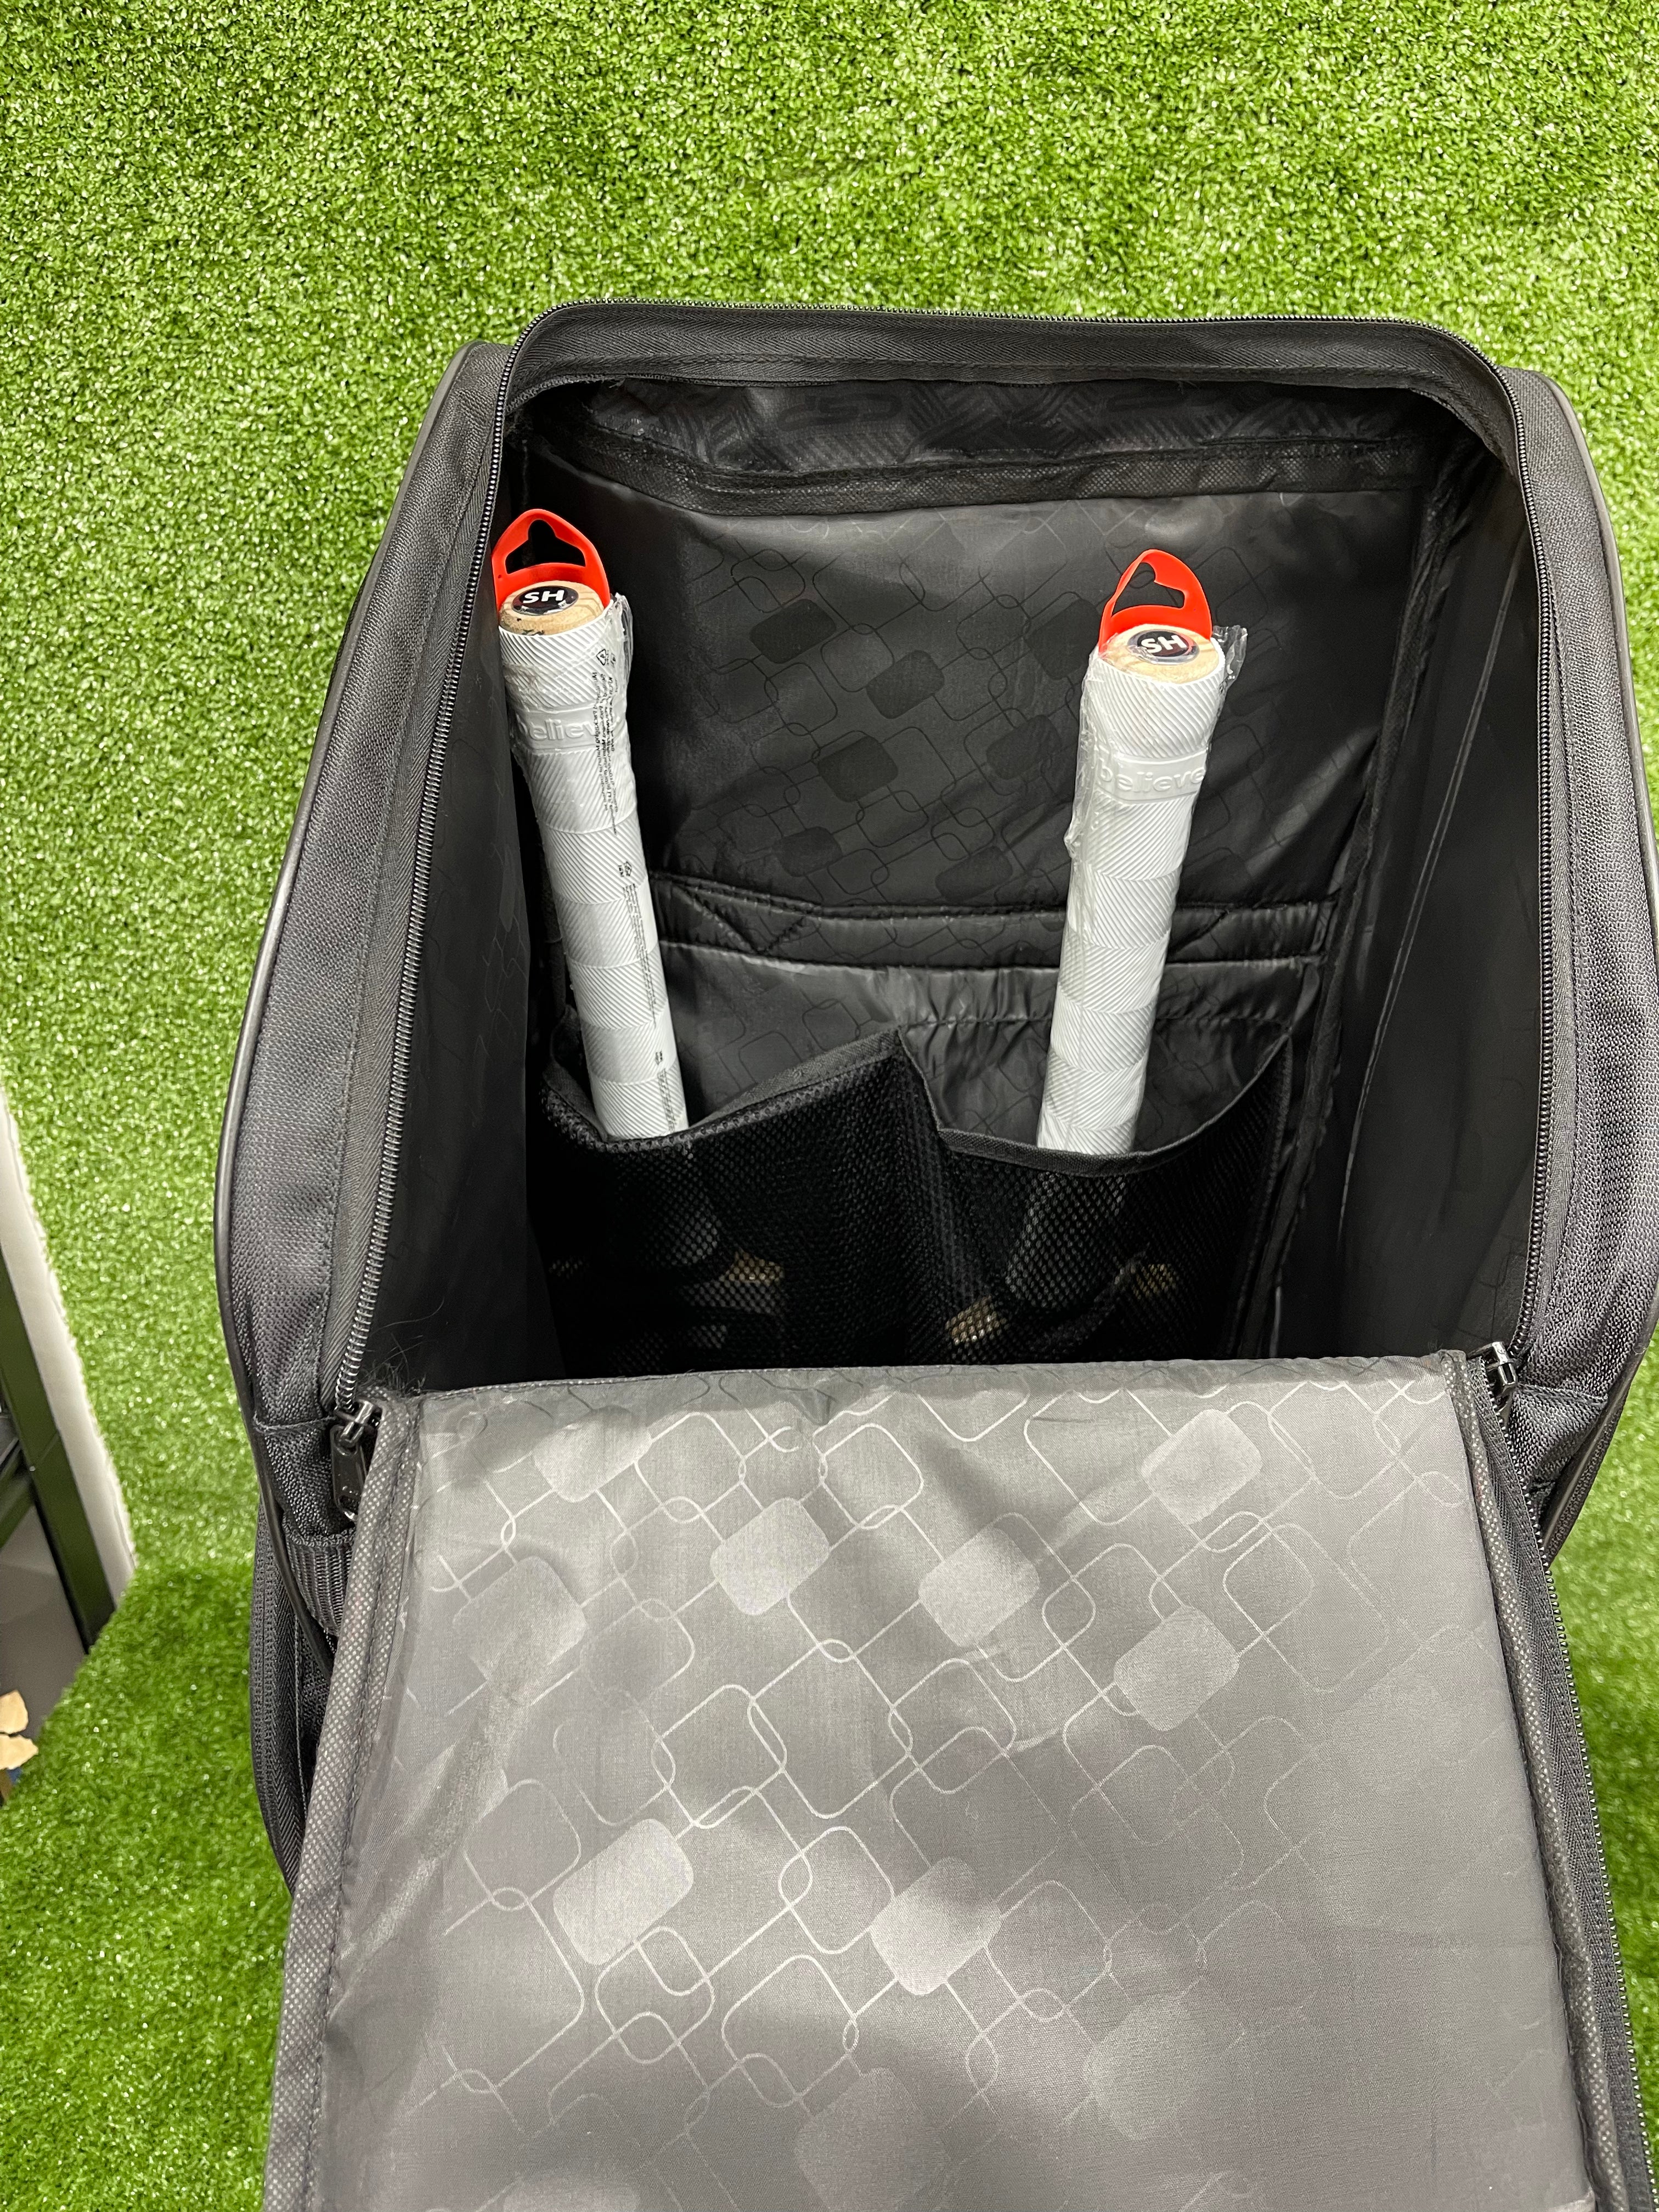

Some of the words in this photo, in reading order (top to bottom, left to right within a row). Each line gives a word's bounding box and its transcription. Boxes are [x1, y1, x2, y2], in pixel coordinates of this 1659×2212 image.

[522, 590, 565, 603] SH
[1141, 635, 1187, 653] SH
[1097, 758, 1205, 792] believe
